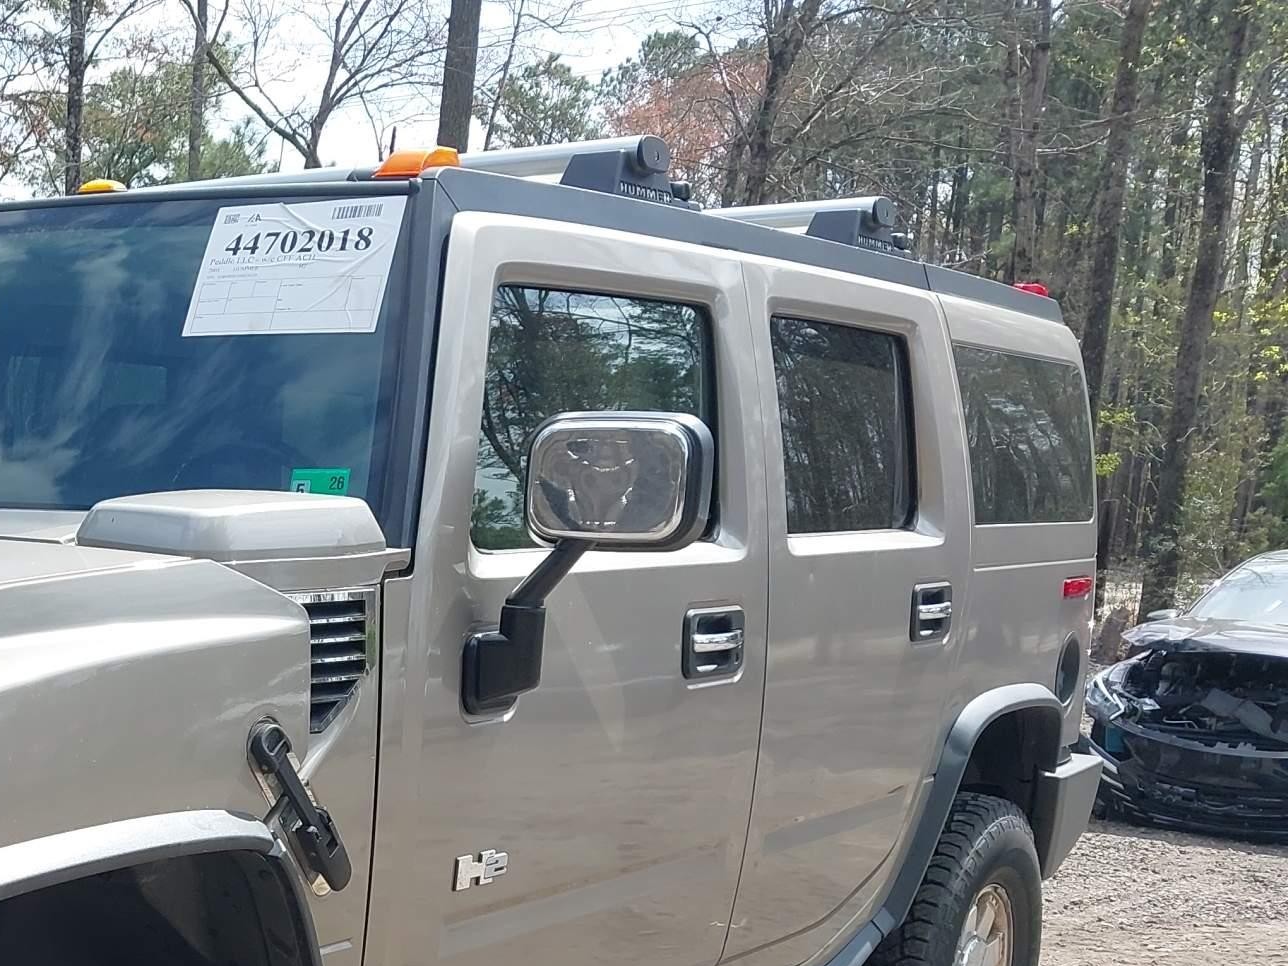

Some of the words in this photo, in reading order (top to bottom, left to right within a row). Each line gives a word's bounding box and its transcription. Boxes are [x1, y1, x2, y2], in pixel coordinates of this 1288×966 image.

[619, 181, 671, 203] HUMMER
[225, 227, 374, 256] 44702018
[296, 483, 305, 493] 5
[452, 849, 508, 891] H2
